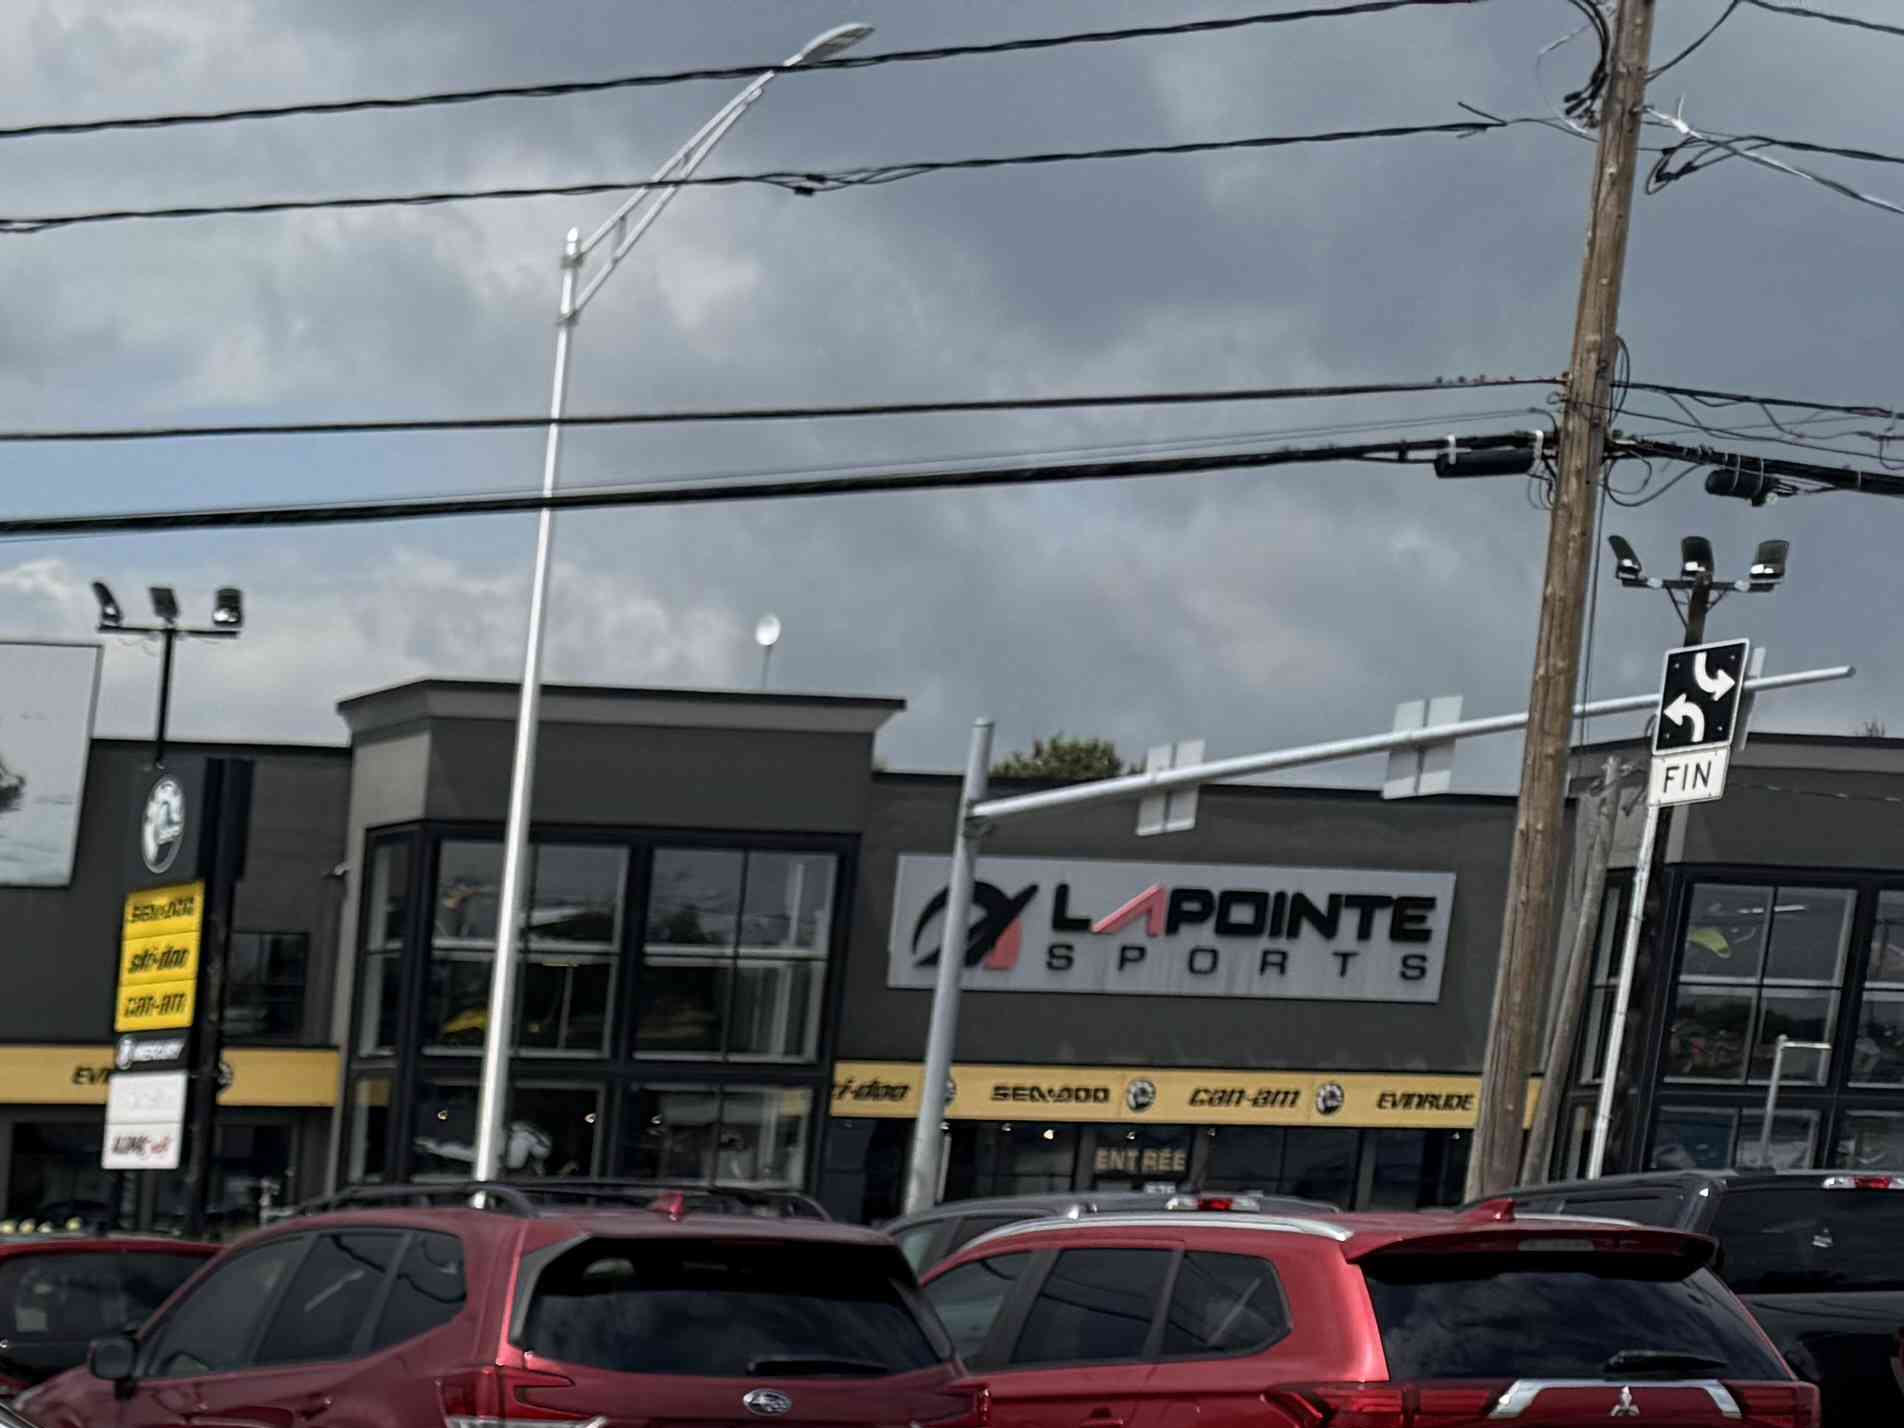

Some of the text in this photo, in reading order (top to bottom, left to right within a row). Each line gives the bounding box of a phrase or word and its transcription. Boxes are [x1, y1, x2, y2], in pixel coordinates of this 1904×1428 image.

[1664, 760, 1712, 793] FIN
[1051, 882, 1438, 943] LAPOINTE
[1046, 943, 1429, 981] SPORTS
[1376, 1091, 1476, 1112] EVINRUDE
